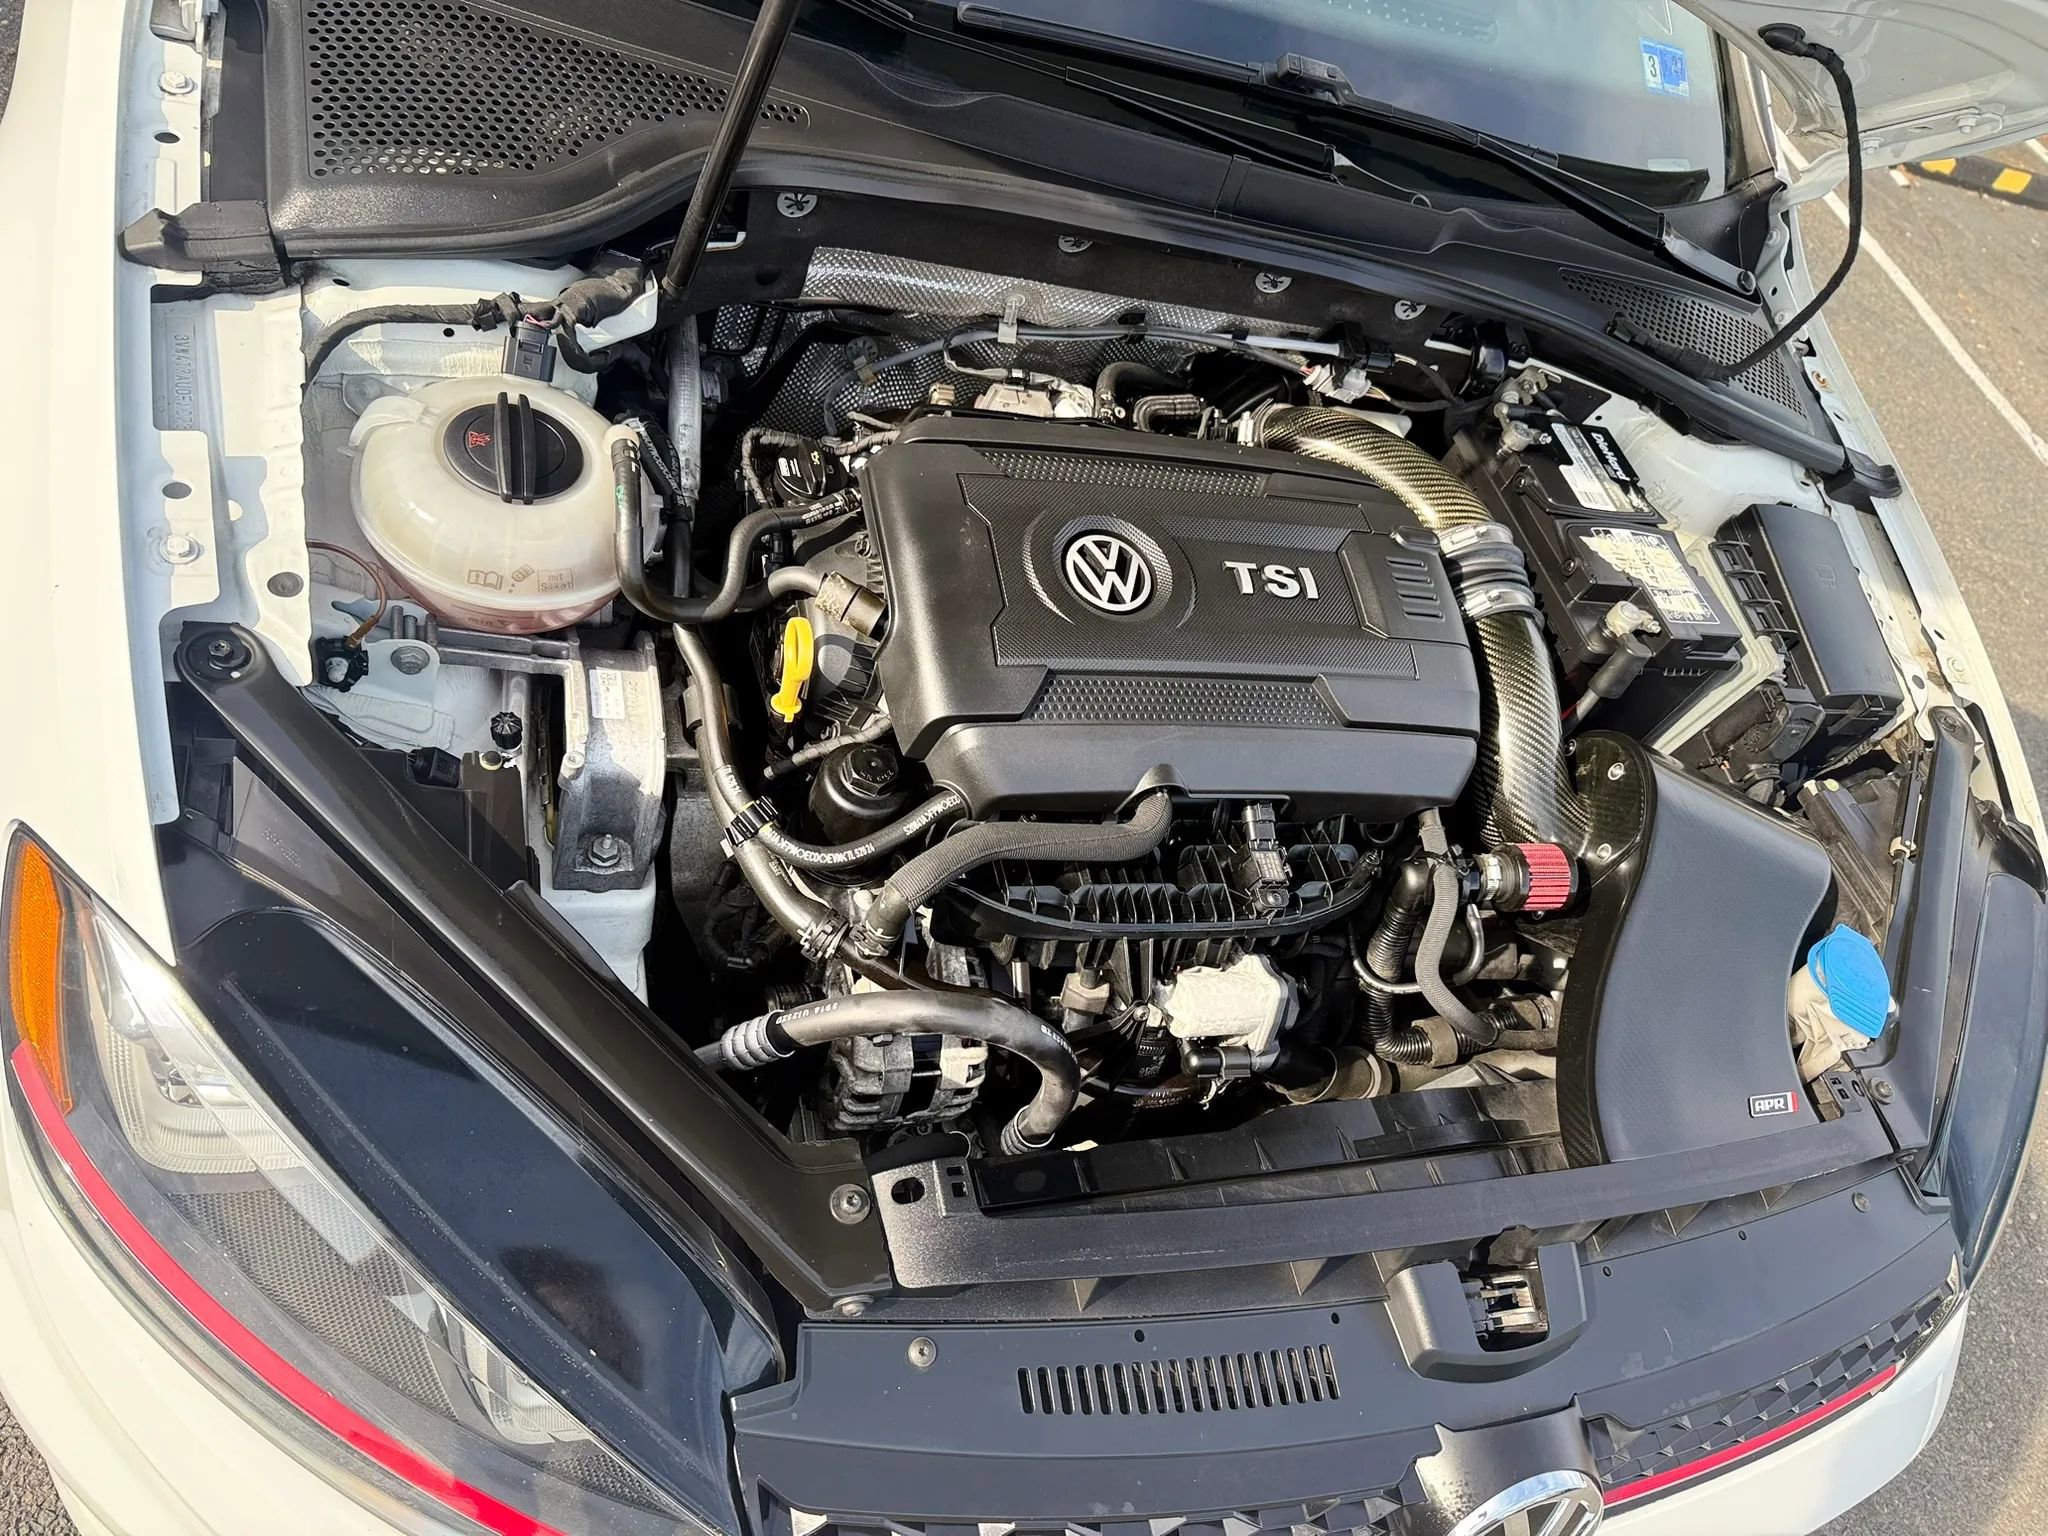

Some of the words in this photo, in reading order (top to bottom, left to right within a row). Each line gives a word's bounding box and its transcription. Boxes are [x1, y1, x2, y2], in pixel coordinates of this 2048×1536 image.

[1648, 55, 1658, 78] 3
[1590, 432, 1631, 482] DieHard
[1221, 560, 1320, 600] TSI
[1754, 1097, 1786, 1112] APR
